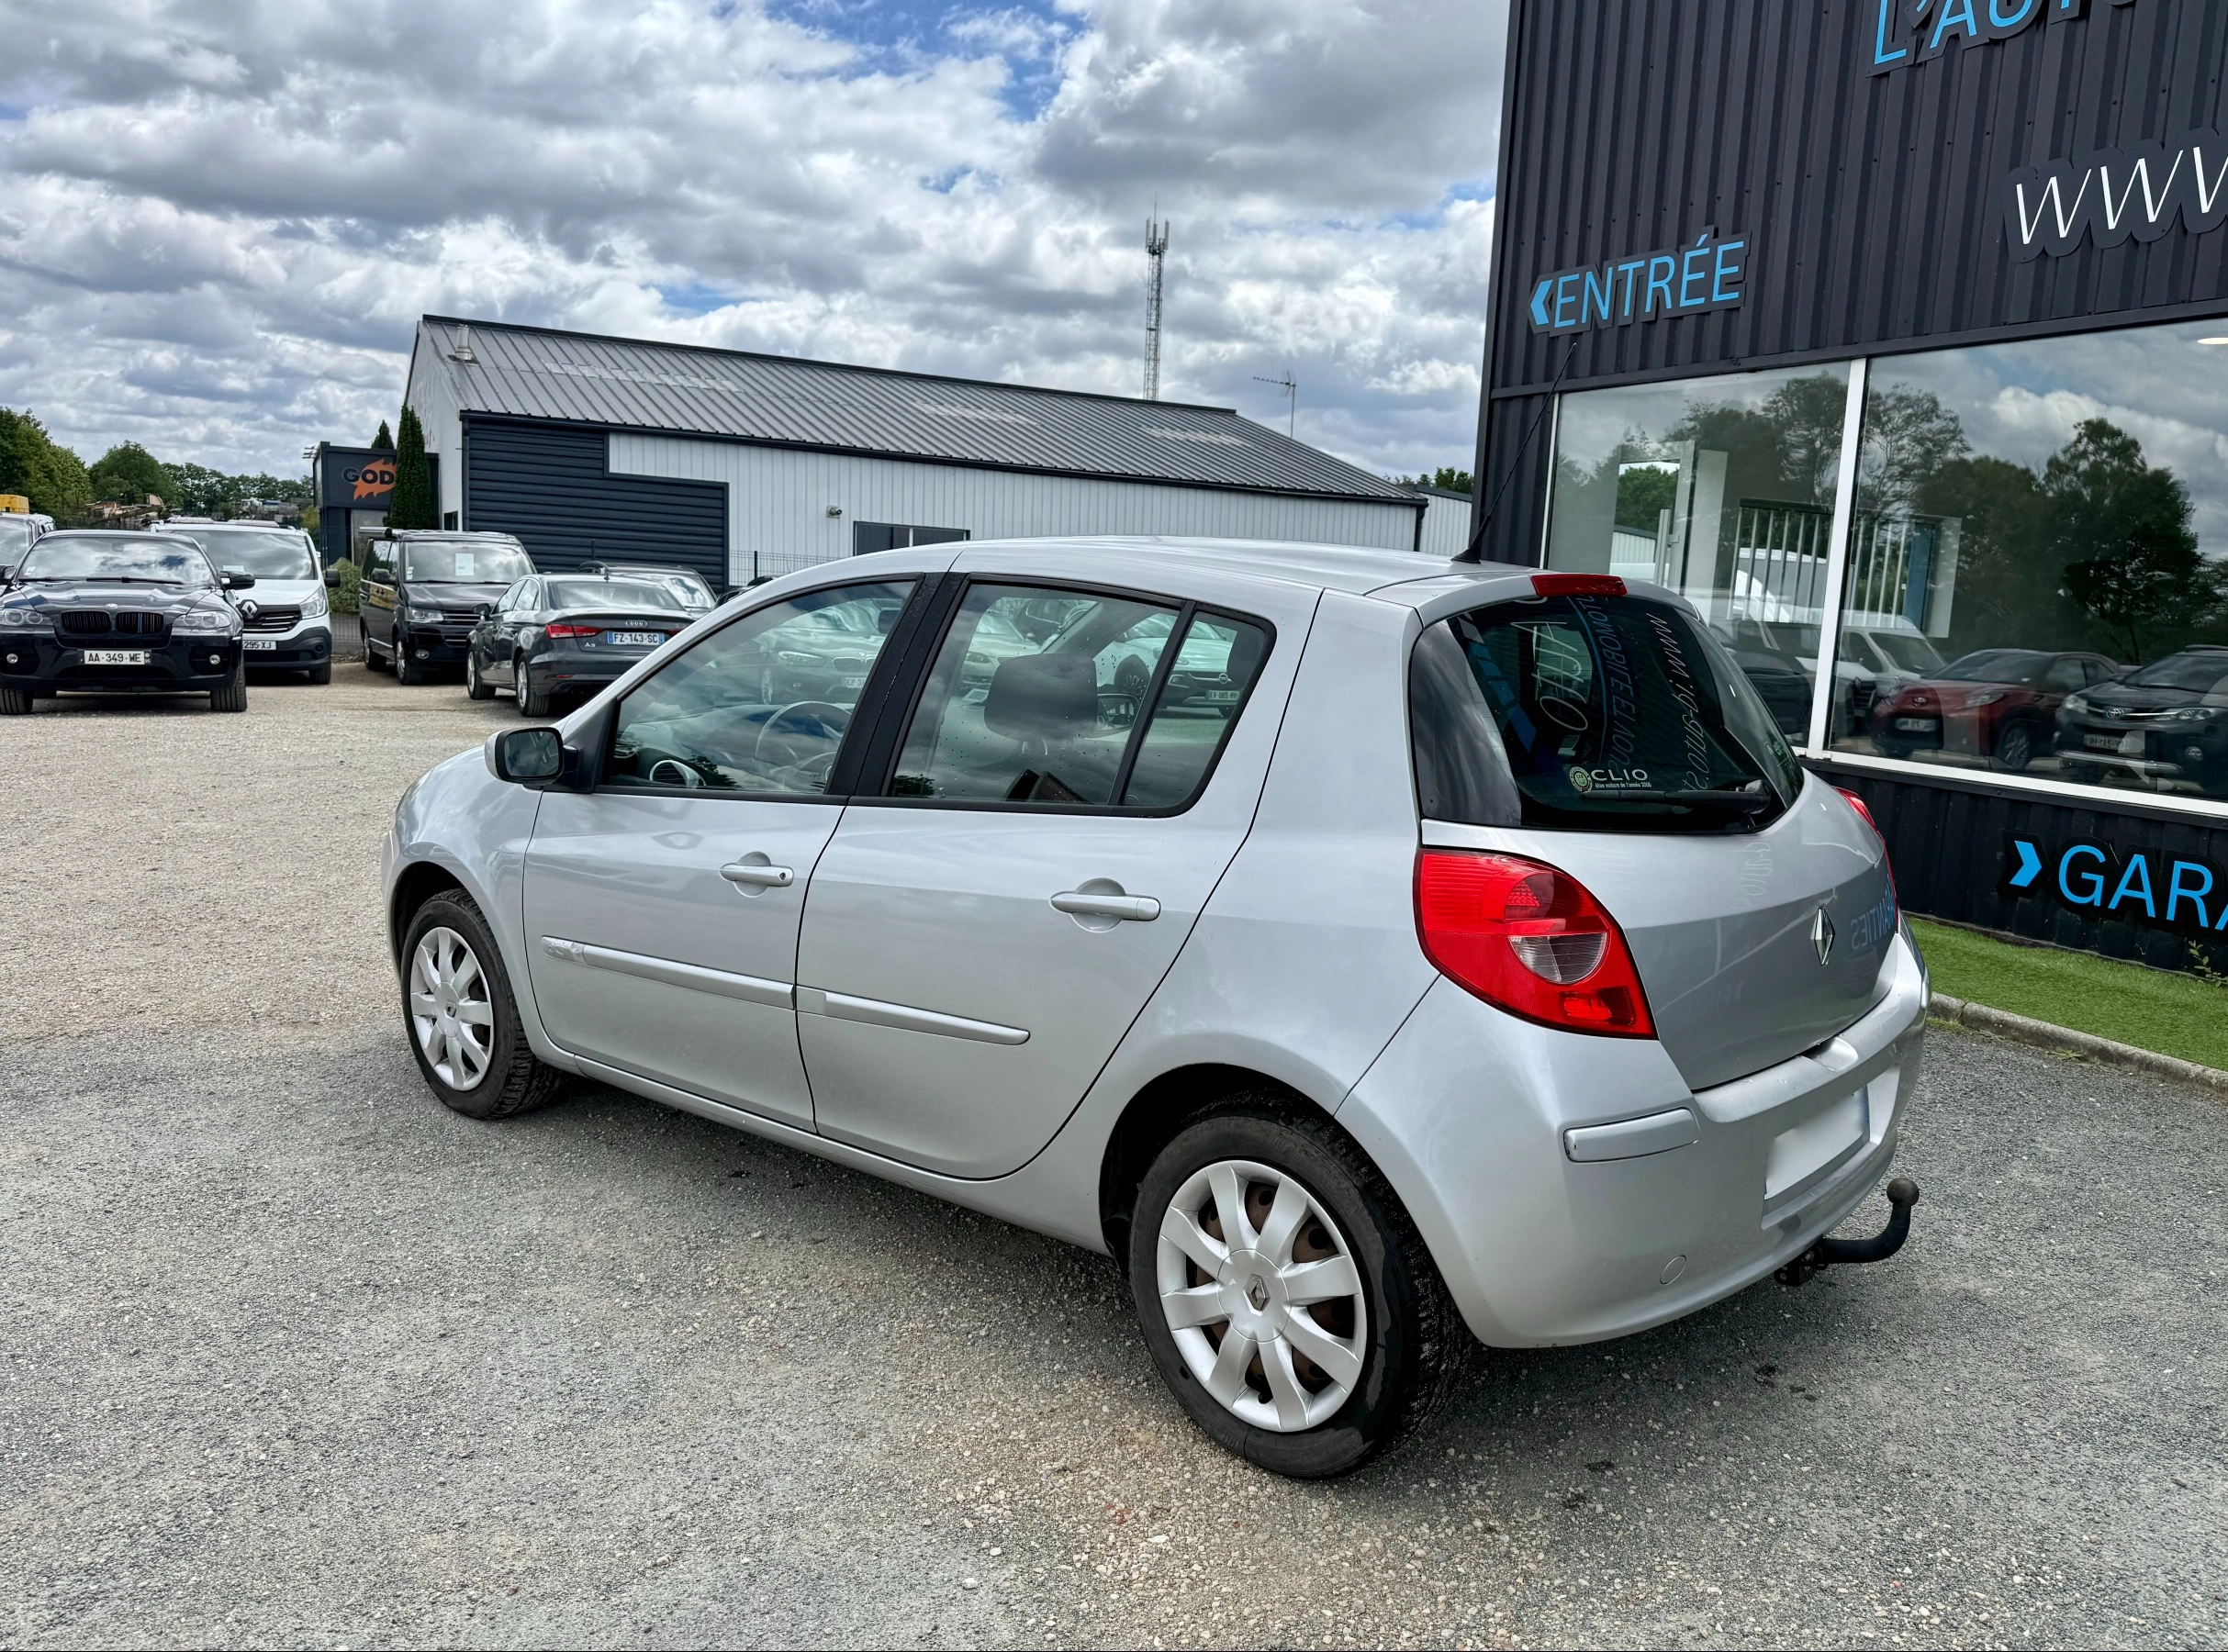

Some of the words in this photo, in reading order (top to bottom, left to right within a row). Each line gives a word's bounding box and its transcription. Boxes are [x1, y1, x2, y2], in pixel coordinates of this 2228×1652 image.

[1553, 233, 1744, 329] ENTRÉE
[614, 632, 658, 643] FZ-143-SC
[88, 653, 141, 663] AA-349-WE
[1591, 768, 1648, 781] CLIO
[2058, 844, 2228, 931] GAR
